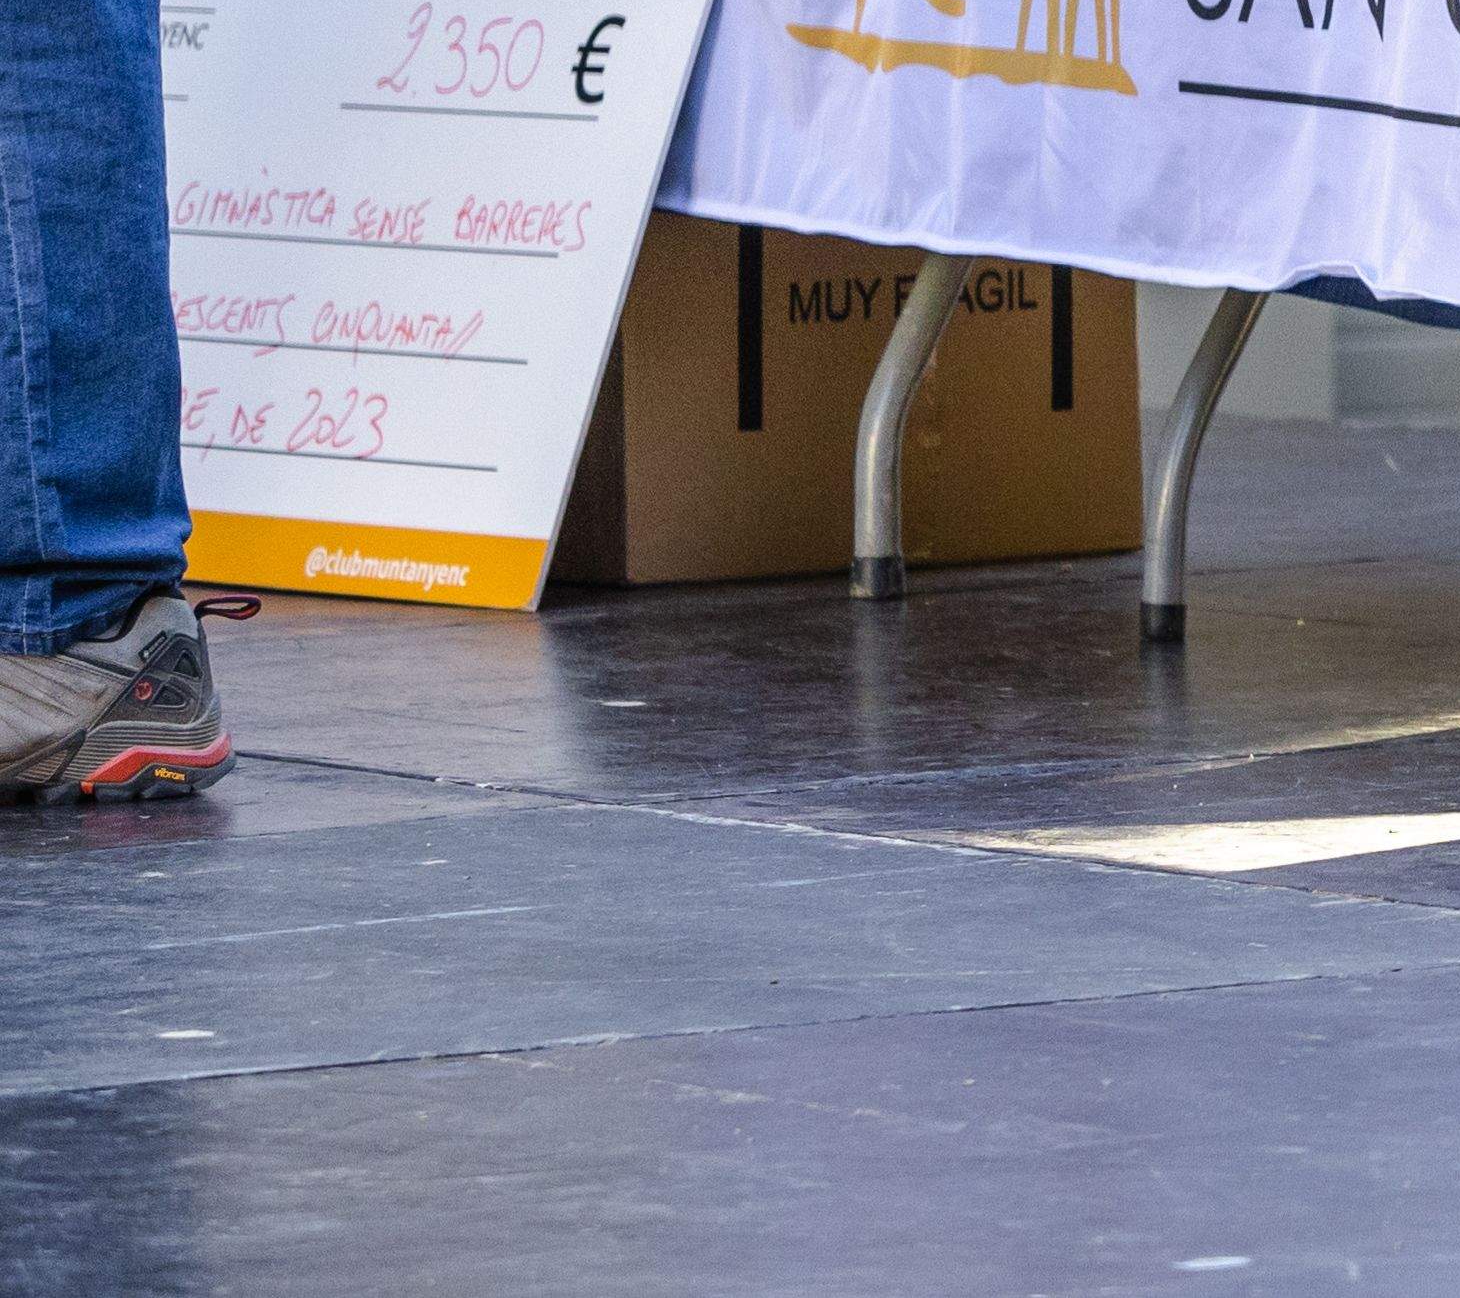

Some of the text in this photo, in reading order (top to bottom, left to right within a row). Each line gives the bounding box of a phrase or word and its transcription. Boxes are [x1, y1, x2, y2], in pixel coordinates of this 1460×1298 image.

[789, 276, 882, 324] MUY
[230, 402, 275, 445] DE
[287, 386, 389, 460] 2023
[305, 545, 470, 592] @clubmuntanyenc
